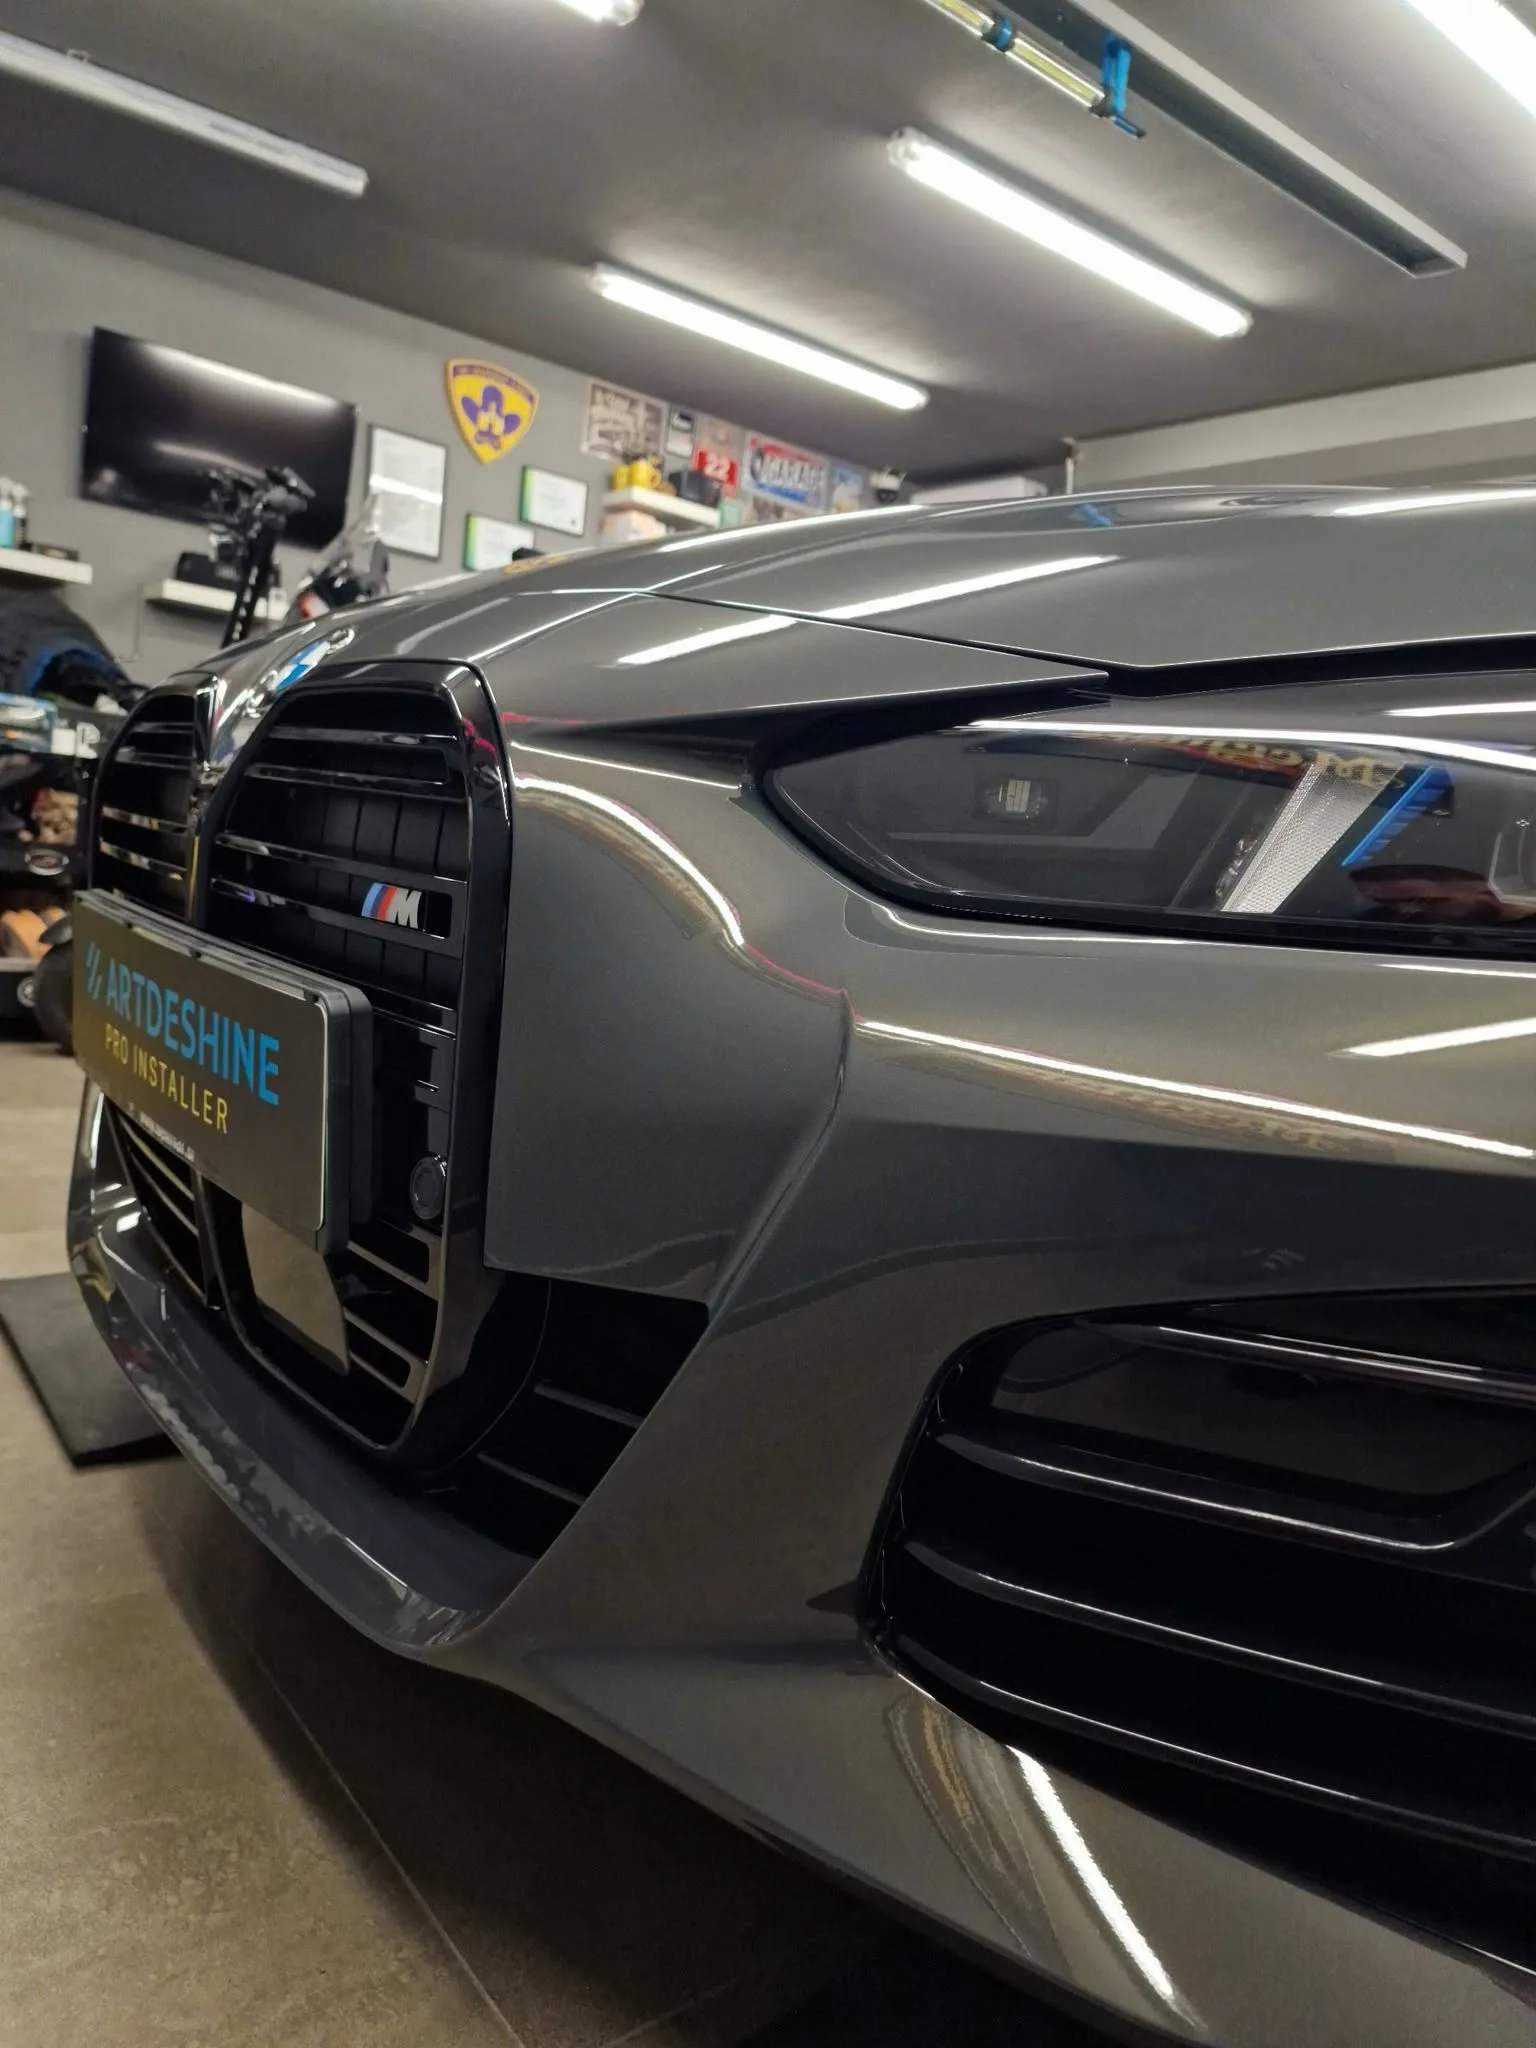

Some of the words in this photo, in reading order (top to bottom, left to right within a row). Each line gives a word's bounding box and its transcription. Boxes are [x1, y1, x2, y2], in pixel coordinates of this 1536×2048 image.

[383, 885, 422, 929] M
[105, 1023, 129, 1065] PRO
[133, 1044, 228, 1134] INSTALLER
[106, 957, 279, 1106] ARTDESHINE
